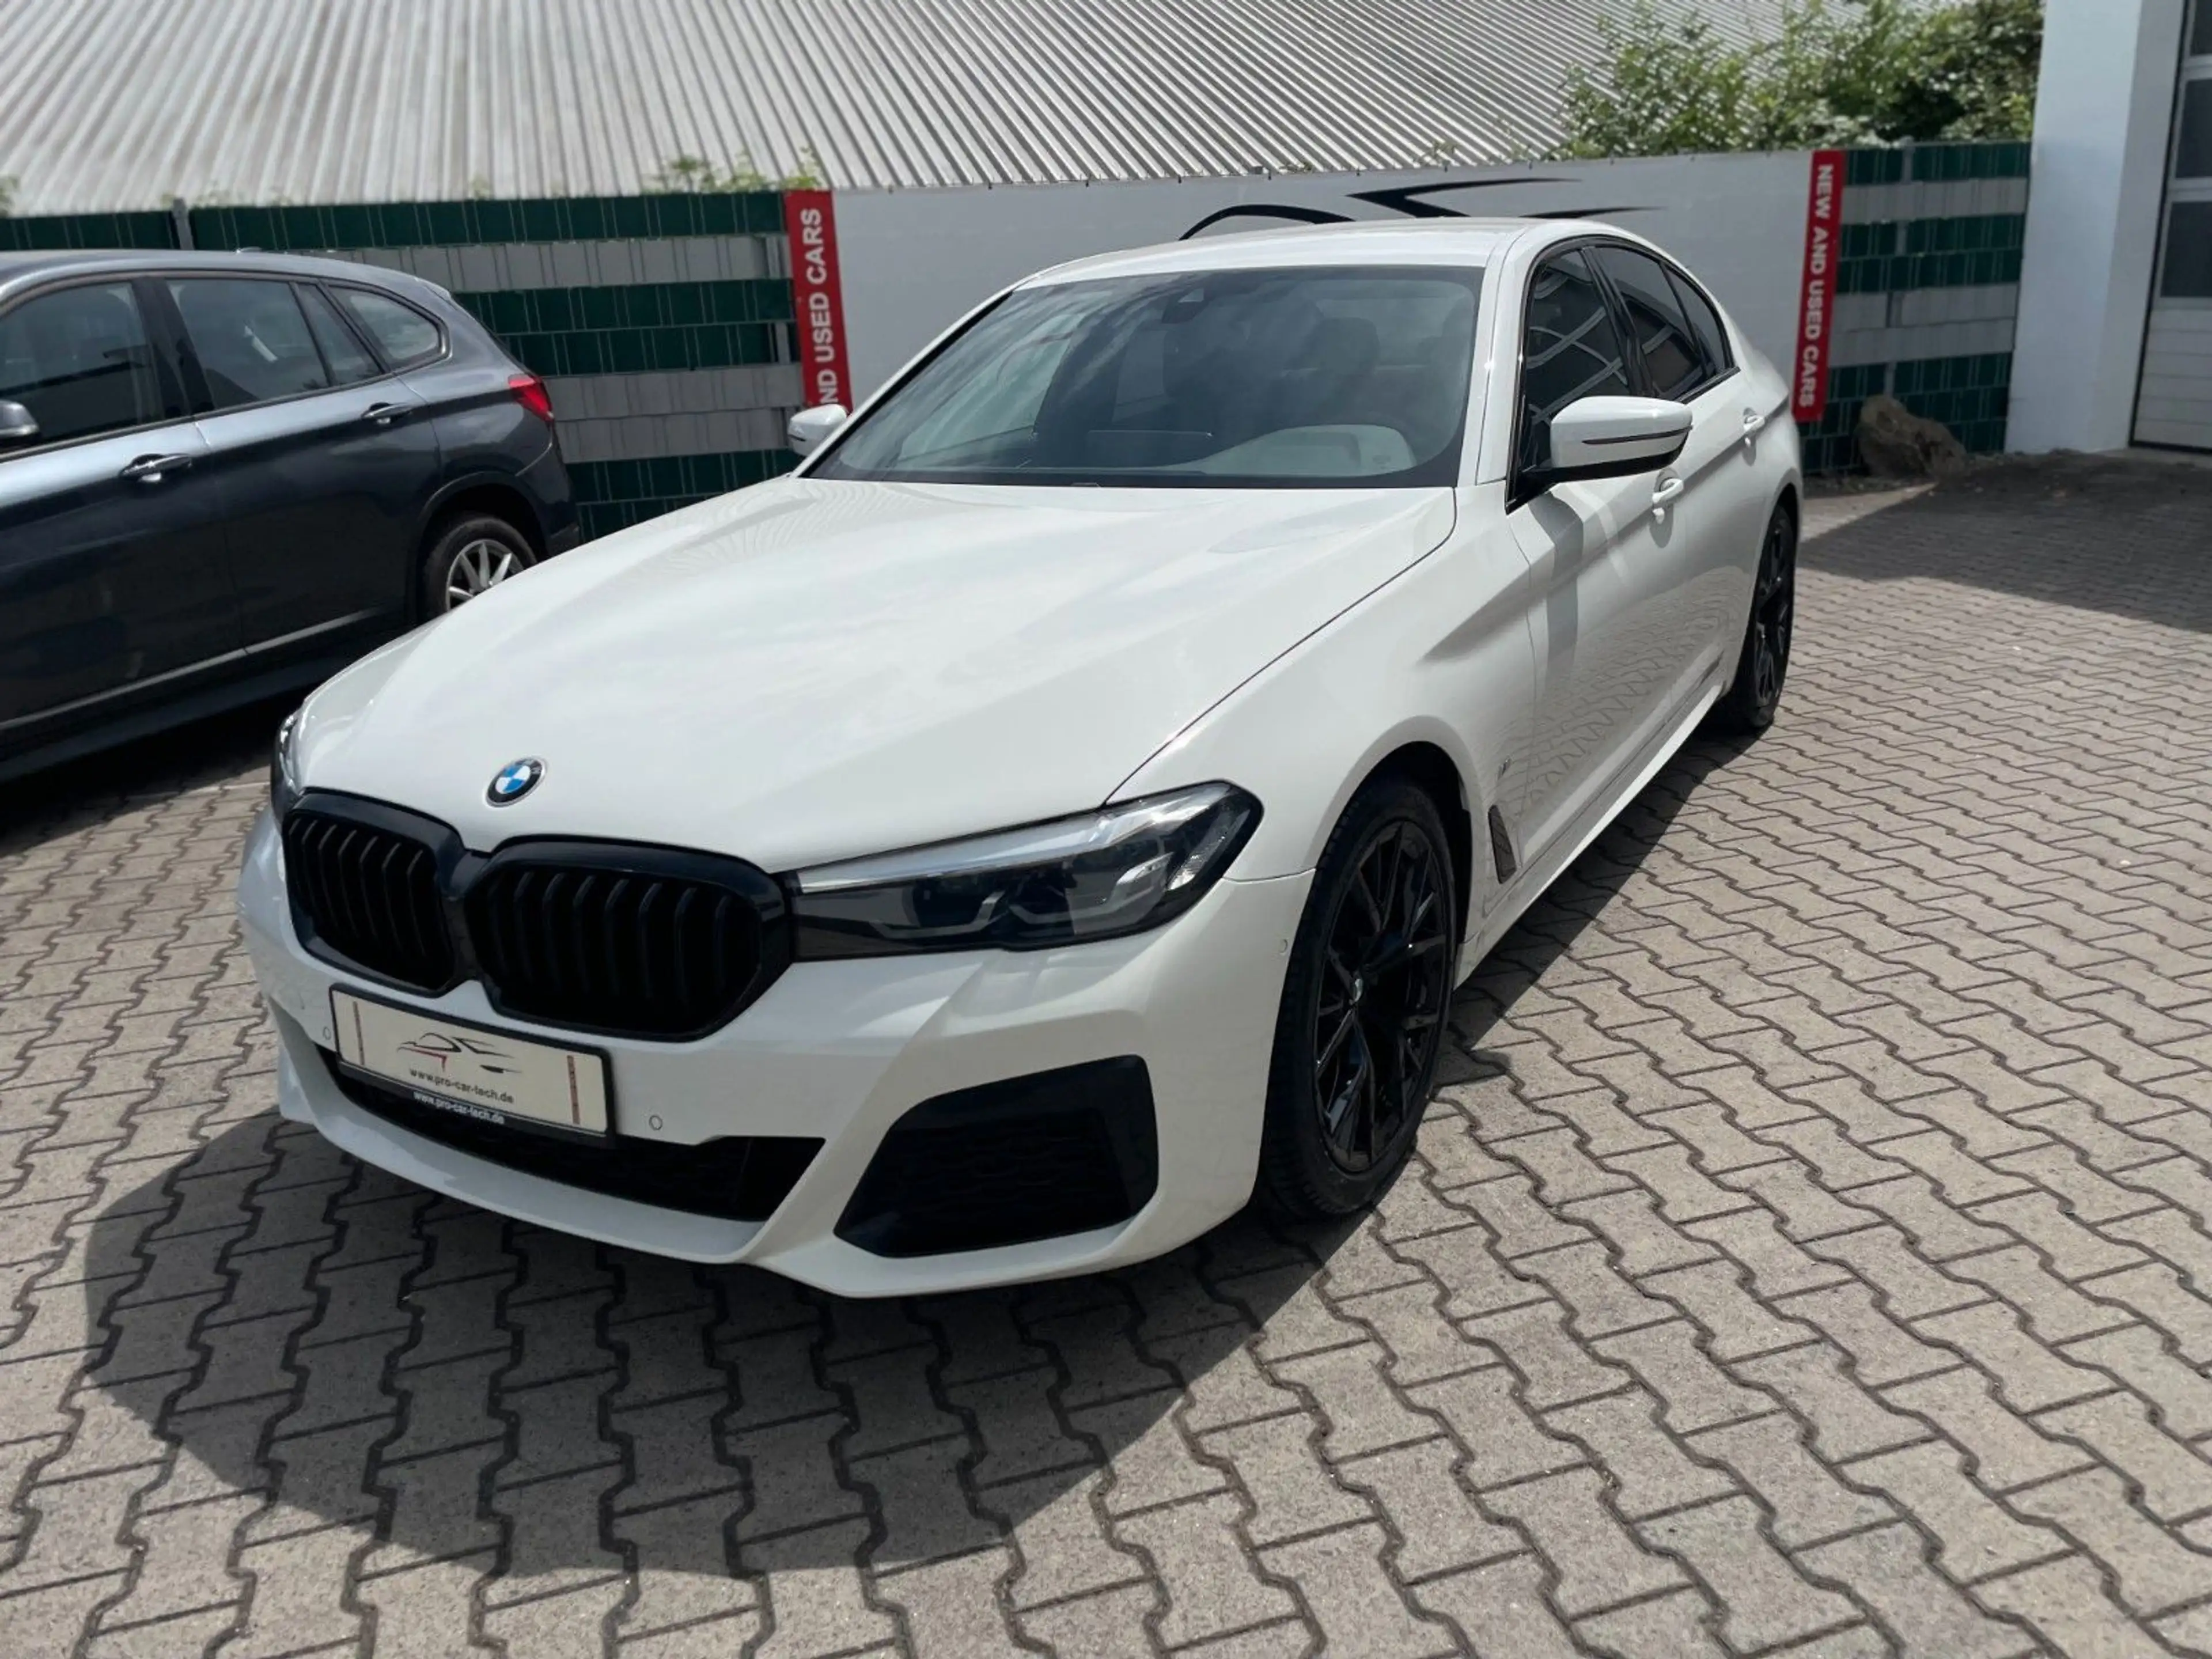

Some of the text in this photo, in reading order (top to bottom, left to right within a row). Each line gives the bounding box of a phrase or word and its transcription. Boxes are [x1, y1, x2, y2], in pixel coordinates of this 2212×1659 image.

[801, 209, 839, 403] ND USED CARS
[1799, 165, 1834, 407] NEW AND USED CARS
[409, 1069, 514, 1103] www.pro-car-tech.de
